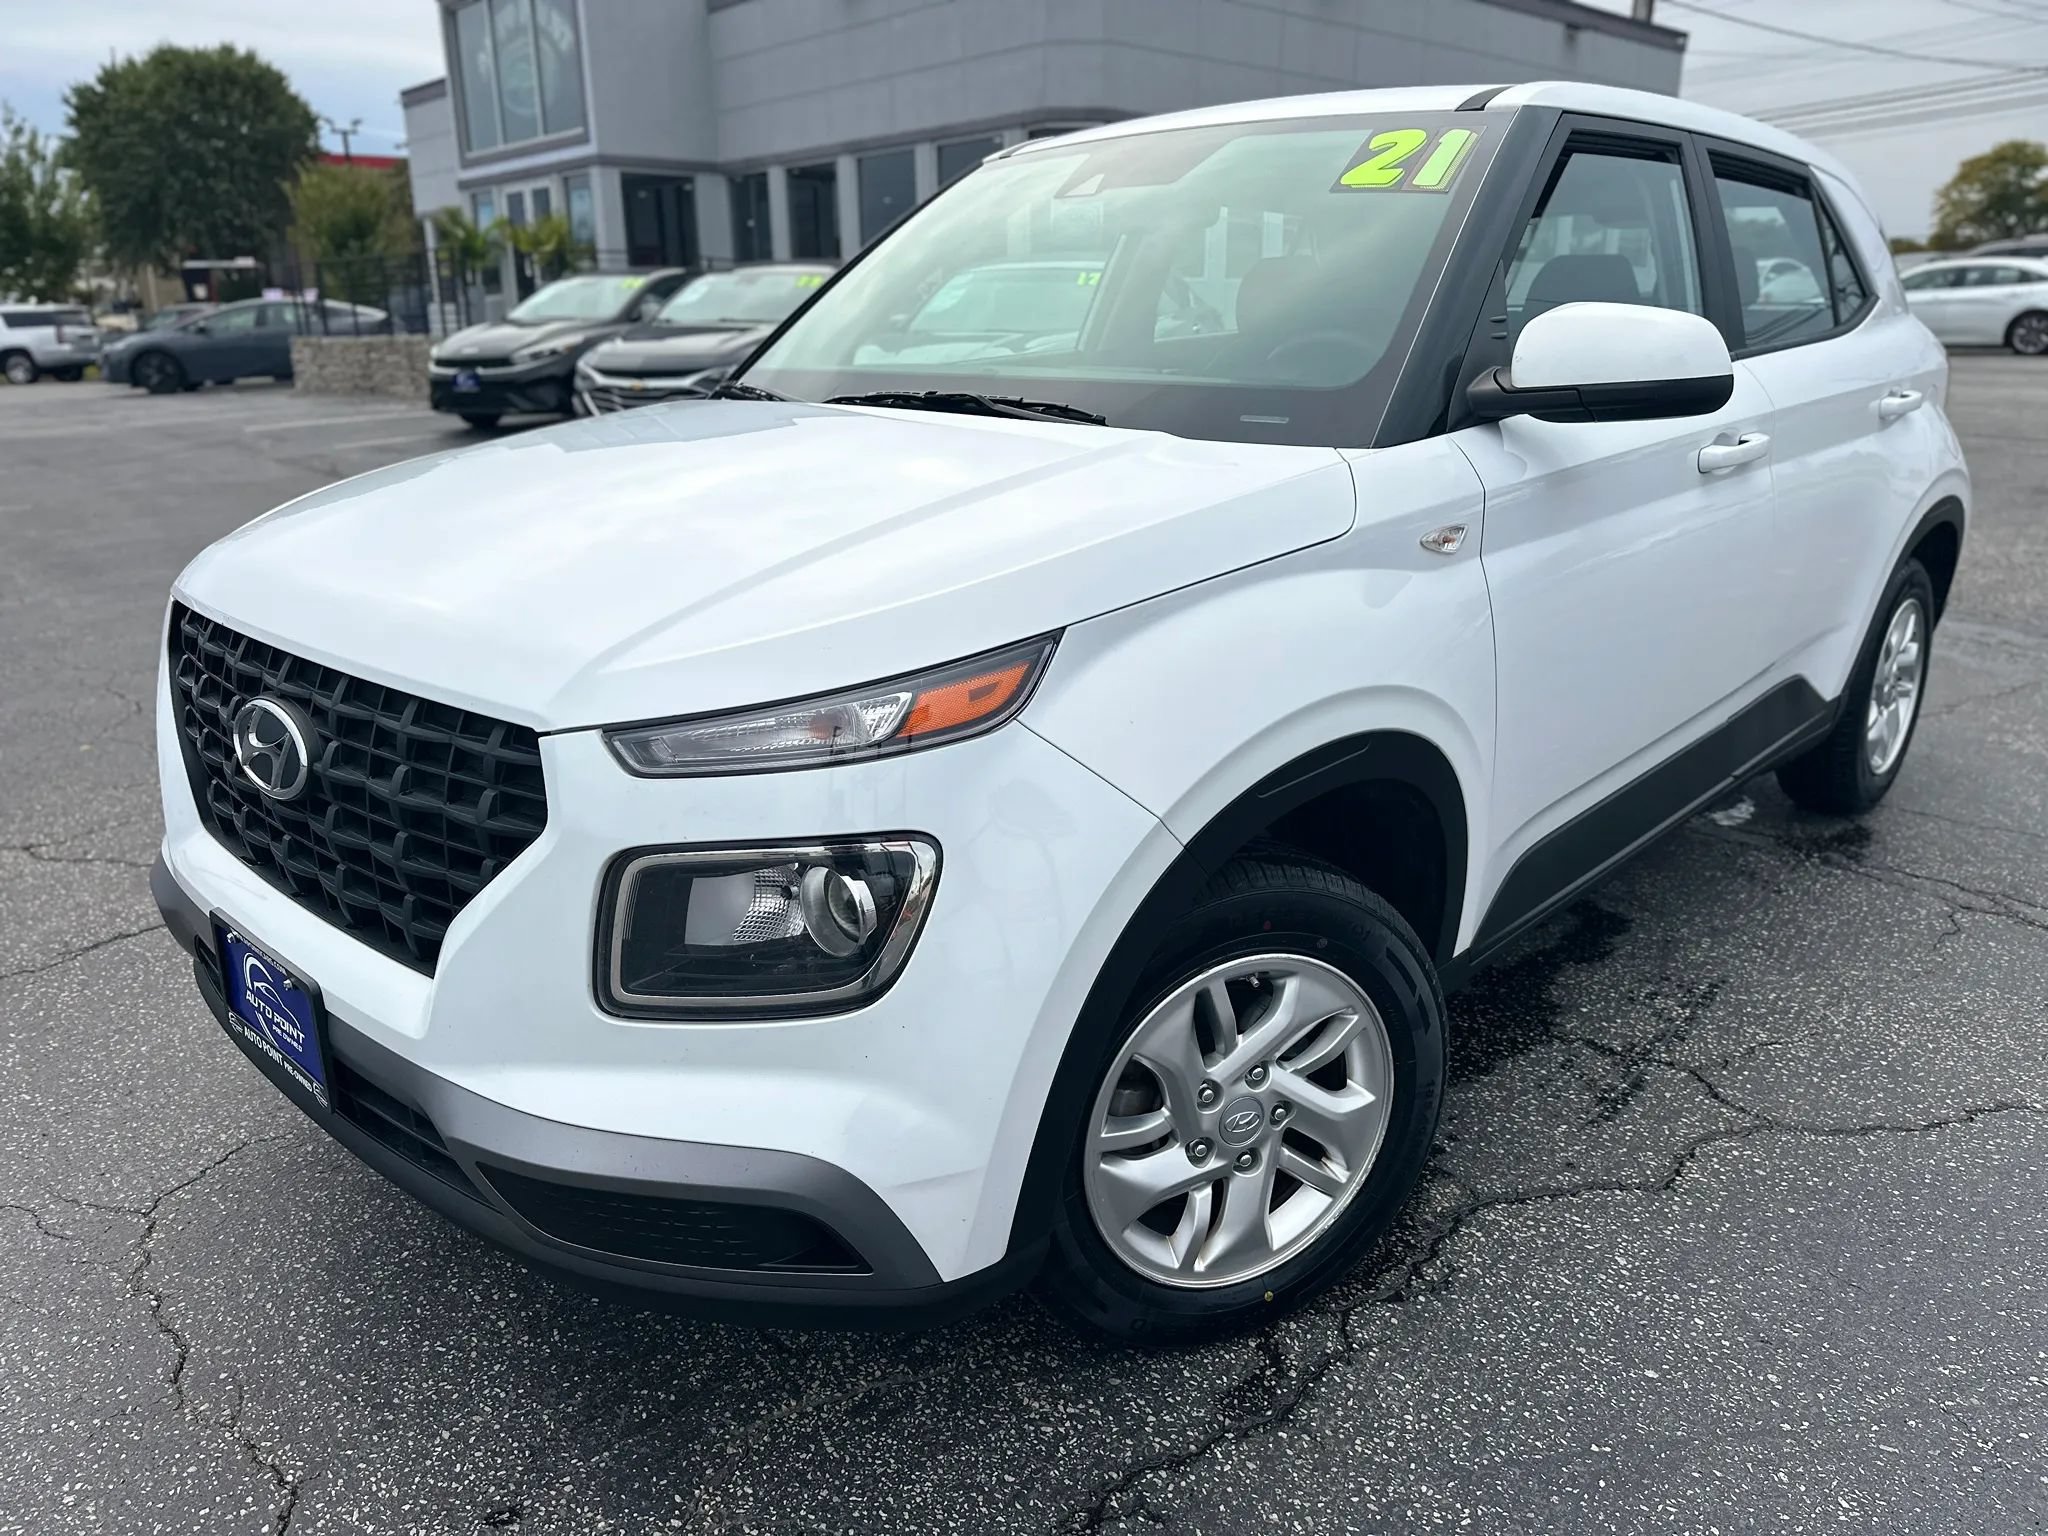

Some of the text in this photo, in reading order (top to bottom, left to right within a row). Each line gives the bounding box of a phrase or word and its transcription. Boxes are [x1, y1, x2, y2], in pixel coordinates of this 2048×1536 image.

[1340, 128, 1478, 189] 21
[246, 990, 305, 1043] AUTO POINT
[245, 1026, 262, 1048] AUTO
[263, 1042, 283, 1065] POINT
